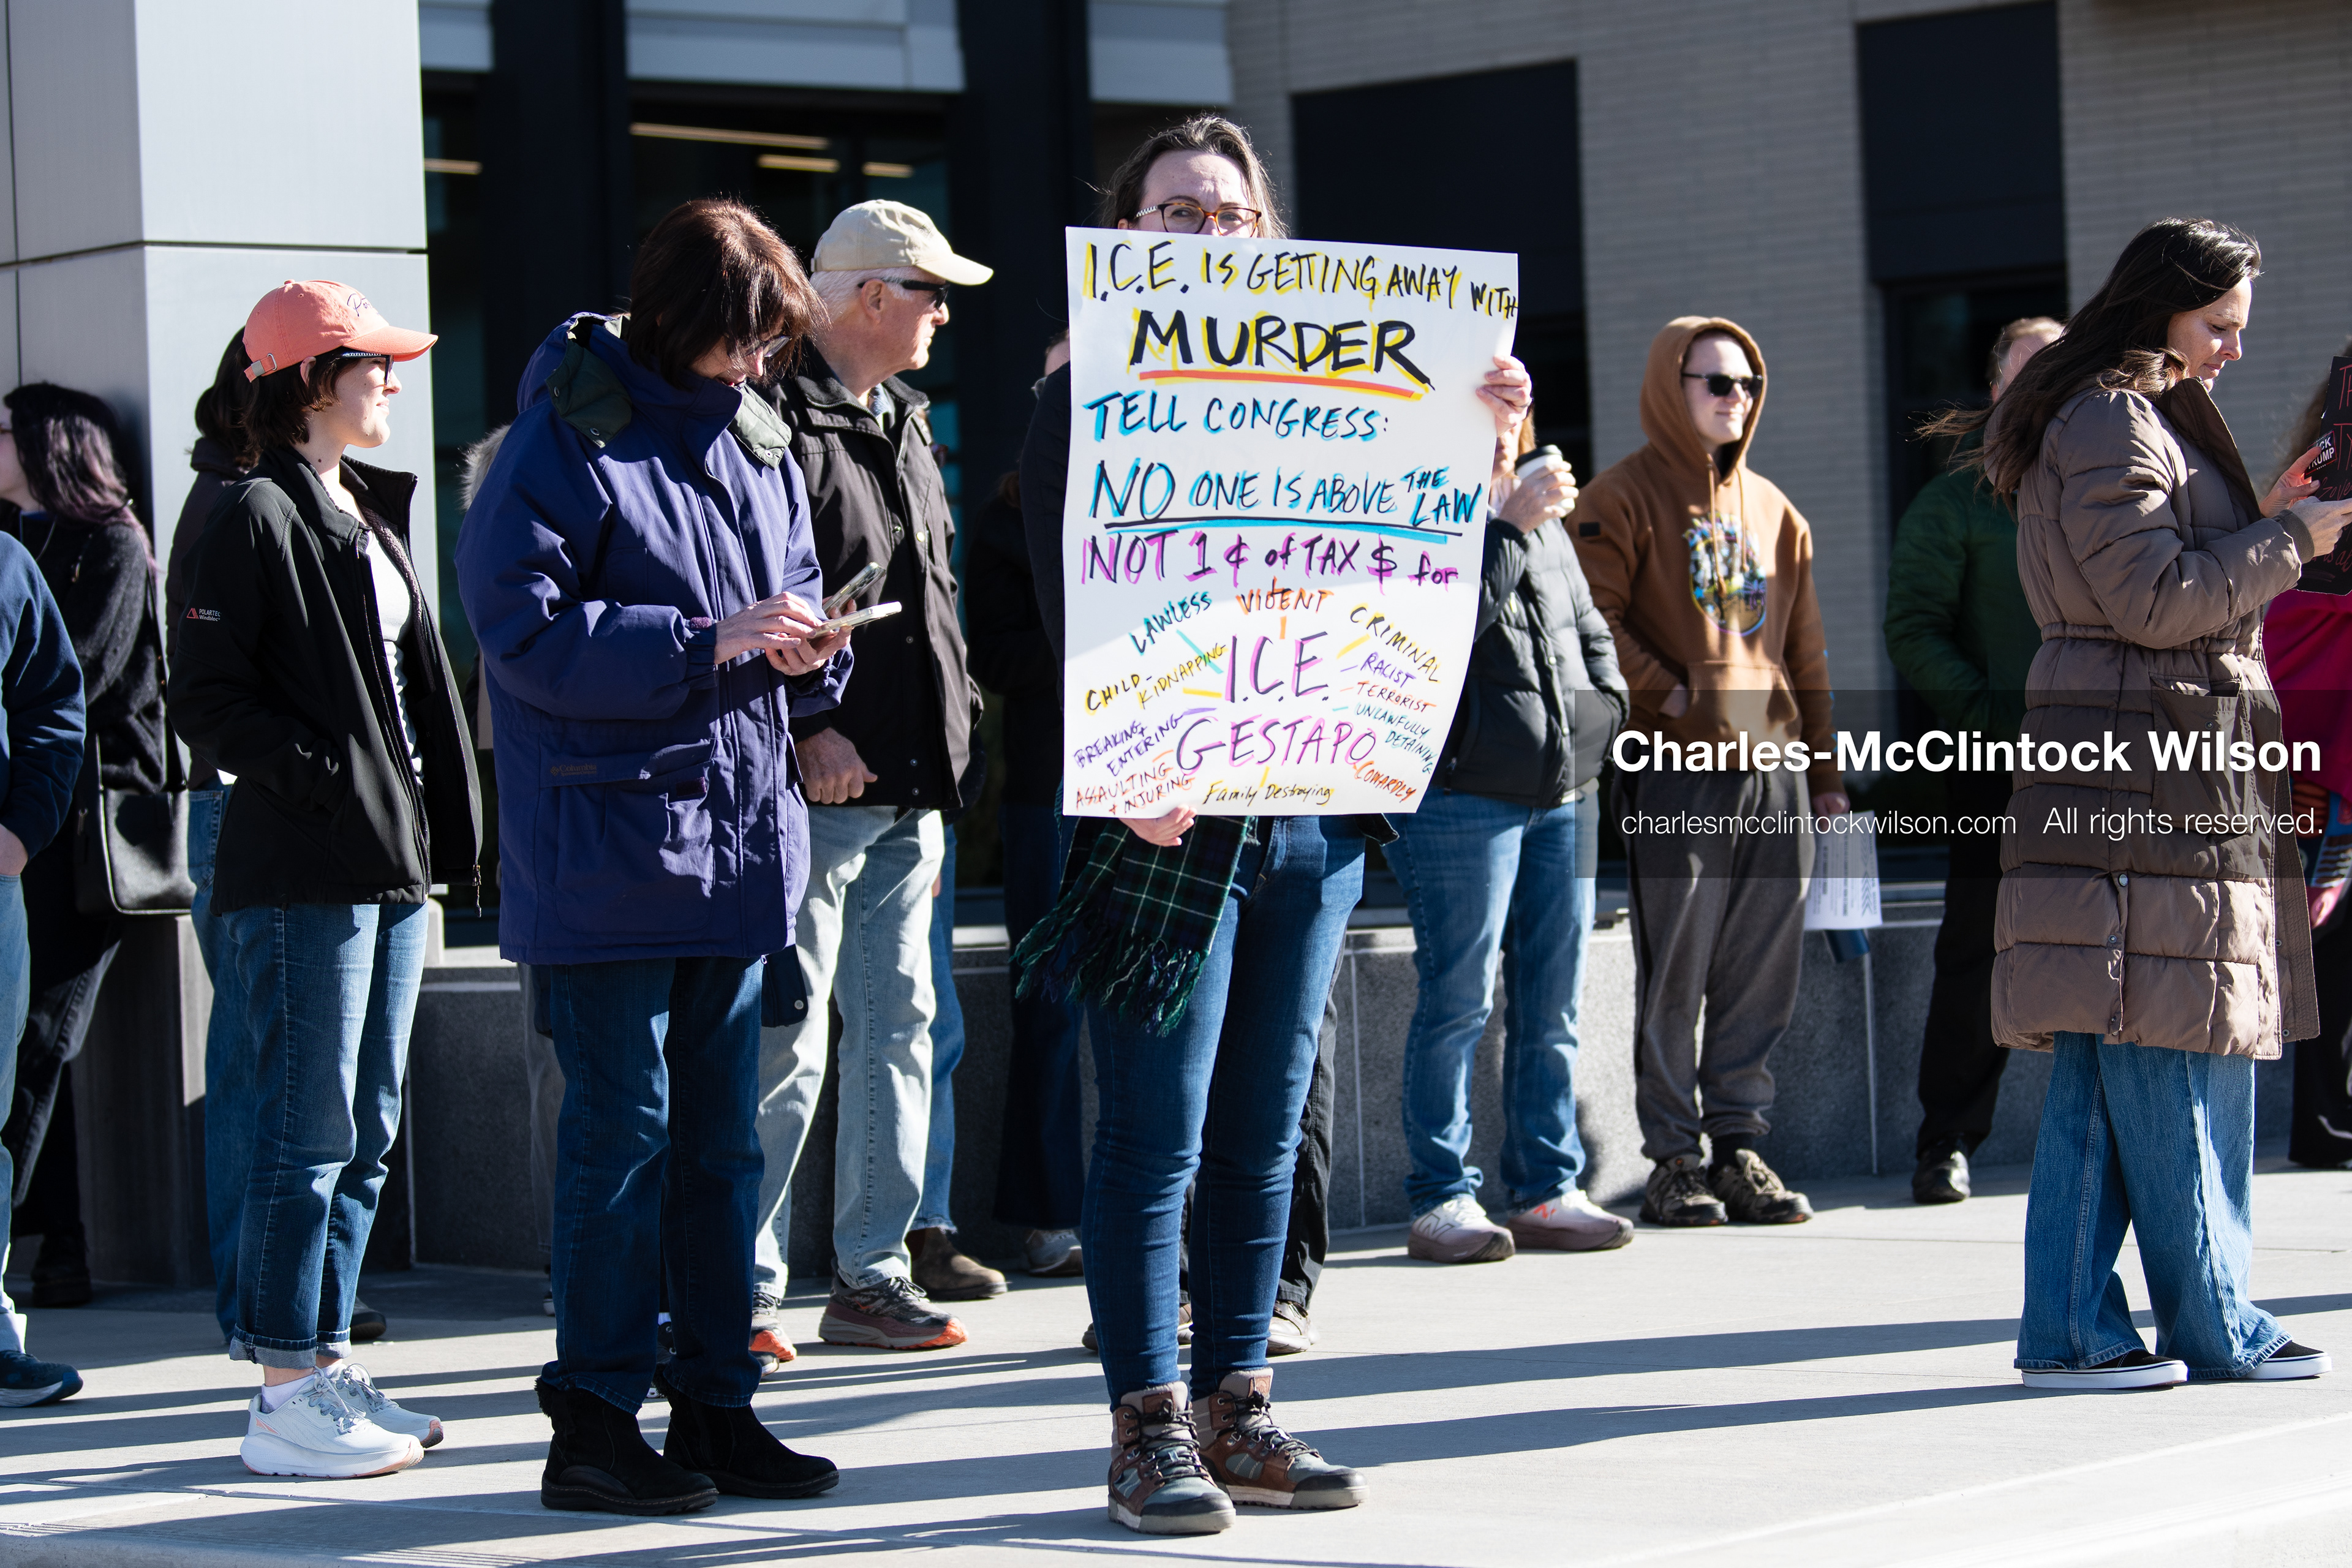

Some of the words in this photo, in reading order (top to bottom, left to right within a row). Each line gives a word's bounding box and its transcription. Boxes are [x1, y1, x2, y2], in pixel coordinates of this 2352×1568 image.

[1084, 241, 1189, 301] I.C.E.
[1200, 249, 1239, 292] IS
[1246, 251, 1378, 300] GETTING
[1387, 263, 1461, 309] AWAY
[1470, 281, 1518, 320] WITH
[1128, 308, 1436, 391] MURDER
[1083, 390, 1187, 441] TELL
[1204, 396, 1389, 441] CONGRESS:
[1403, 466, 1450, 490] THE
[2309, 447, 2335, 470] RUMP
[1089, 458, 1176, 521] NO
[1189, 469, 1261, 511] ONE
[1272, 466, 1305, 509] IS
[1307, 472, 1399, 514] ABOVE
[1409, 481, 1483, 527] LAW
[1081, 529, 1179, 585] NOT
[1264, 531, 1297, 567] of
[1300, 534, 1361, 578] TAX
[1408, 551, 1459, 592] for
[199, 608, 221, 617] POLARTEC
[1128, 591, 1212, 657] LAWLESS
[1350, 603, 1441, 684] CRIMINAL
[1137, 642, 1229, 710] KIDNAPPING
[1224, 630, 1329, 704] I.C.E.
[1360, 651, 1417, 688] RACIST
[1357, 680, 1437, 712] TERRORIST
[1354, 701, 1432, 739] UNLAWFULLY
[559, 763, 597, 772] Columbia
[1106, 713, 1184, 777] ENTERING
[1176, 714, 1378, 776] GESTAPO
[1384, 729, 1438, 775] DETAINING
[1076, 761, 1174, 812] ASSAULTING
[1124, 774, 1196, 814] INJURING
[1202, 780, 1258, 807] Family
[1264, 783, 1335, 807] Destroying
[1354, 760, 1417, 804] COWARDLY
